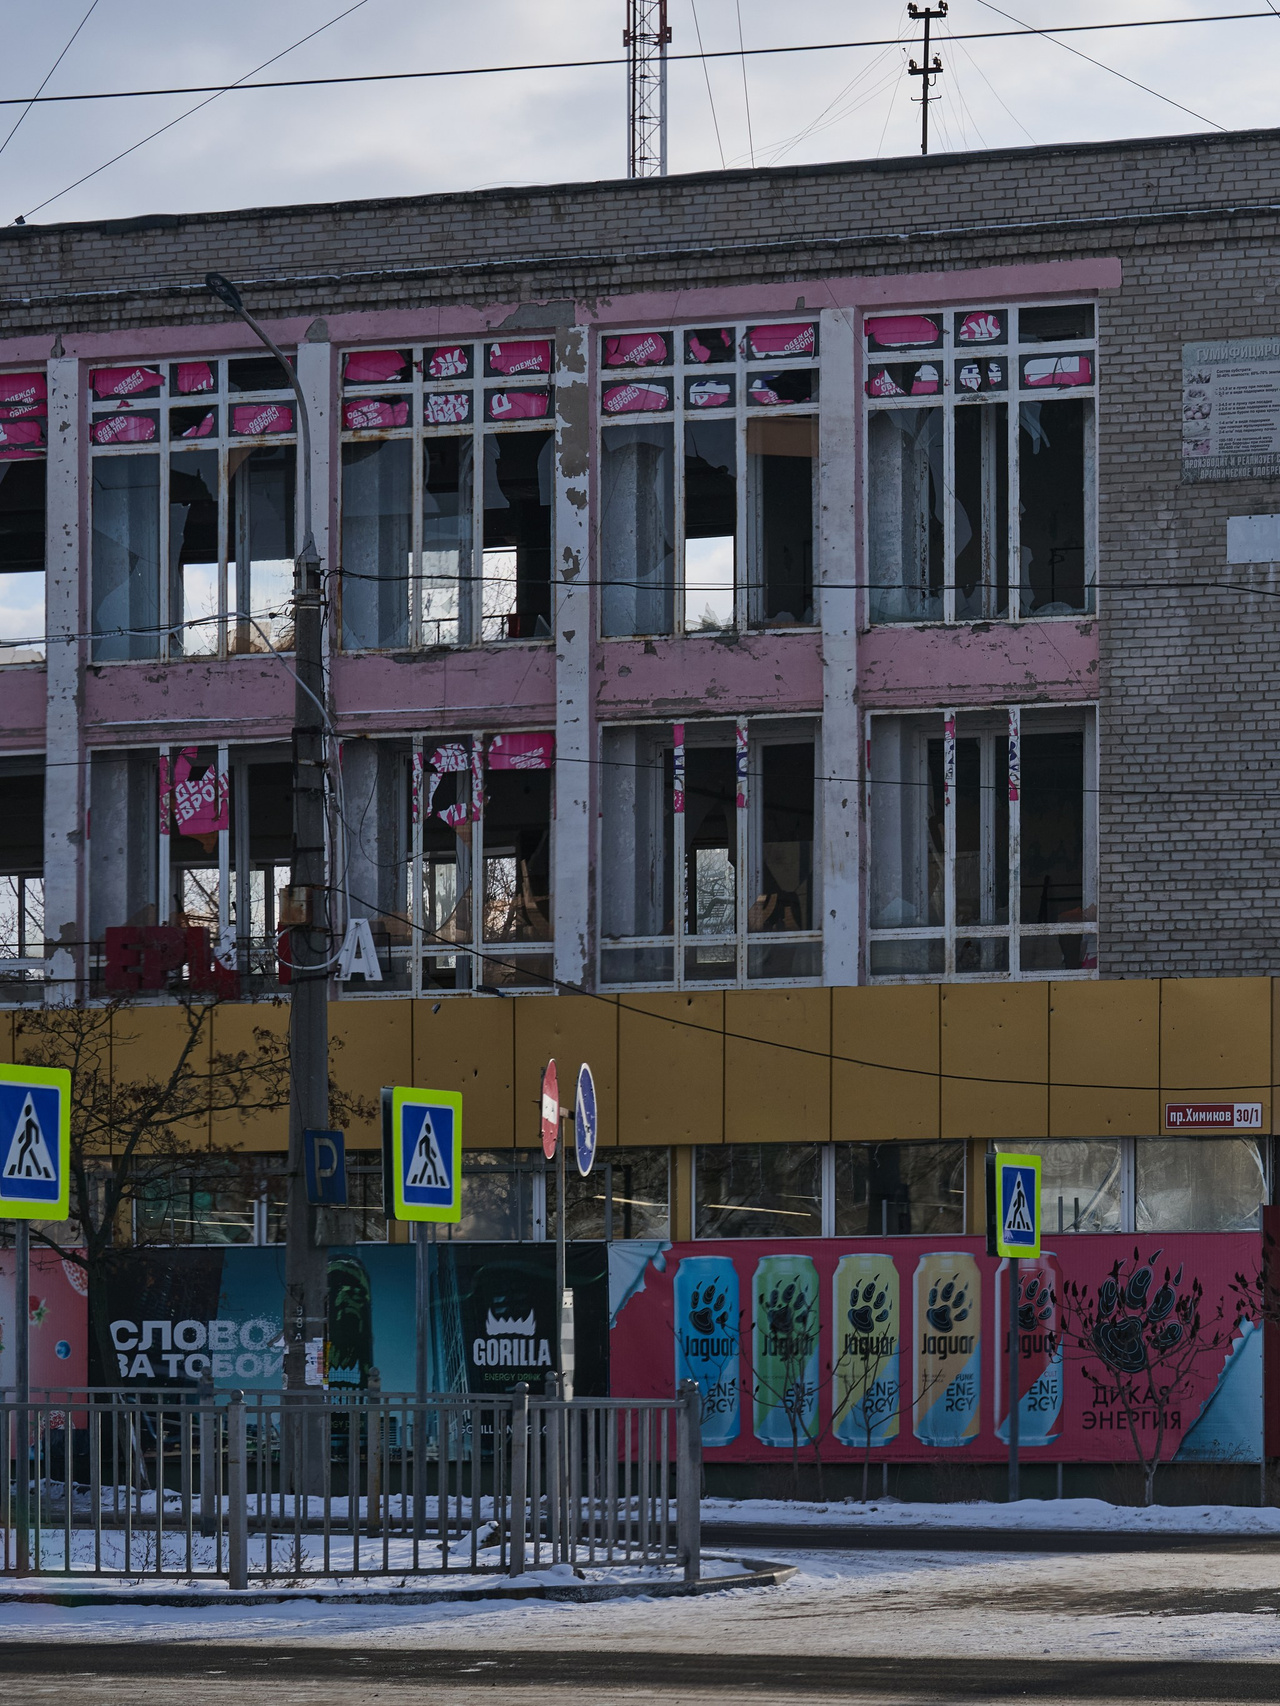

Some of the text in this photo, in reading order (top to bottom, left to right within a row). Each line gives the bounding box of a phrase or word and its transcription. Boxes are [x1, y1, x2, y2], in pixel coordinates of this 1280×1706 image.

[624, 337, 654, 362] ОДЕЖДА
[114, 370, 141, 393] ОДЕЖДА
[249, 406, 277, 429] ОДЕЖДА
[251, 411, 279, 434] ЕВРОПЫ
[1184, 457, 1228, 469] ПРОИЗВОДИТ
[1238, 454, 1275, 466] РЕАЛИЗУЕТ
[1200, 466, 1251, 479] ОРГАНИЧЕСКОЕ
[1170, 1108, 1259, 1125] пр.Химиков 30/1
[473, 1338, 552, 1366] GORILLA
[685, 1336, 736, 1362] Jaguar
[921, 1333, 975, 1360] Jaguar
[485, 1373, 542, 1381] ENERGY DRINK
[956, 1372, 974, 1381] FUNK
[946, 1381, 975, 1397] ENE
[1029, 1380, 1058, 1395] ENE
[1028, 1398, 1058, 1412] RGY
[1092, 1386, 1170, 1408] ДИКАЯ
[945, 1400, 974, 1413] RGY
[1082, 1411, 1182, 1430] ЭНЕРГИЯ
